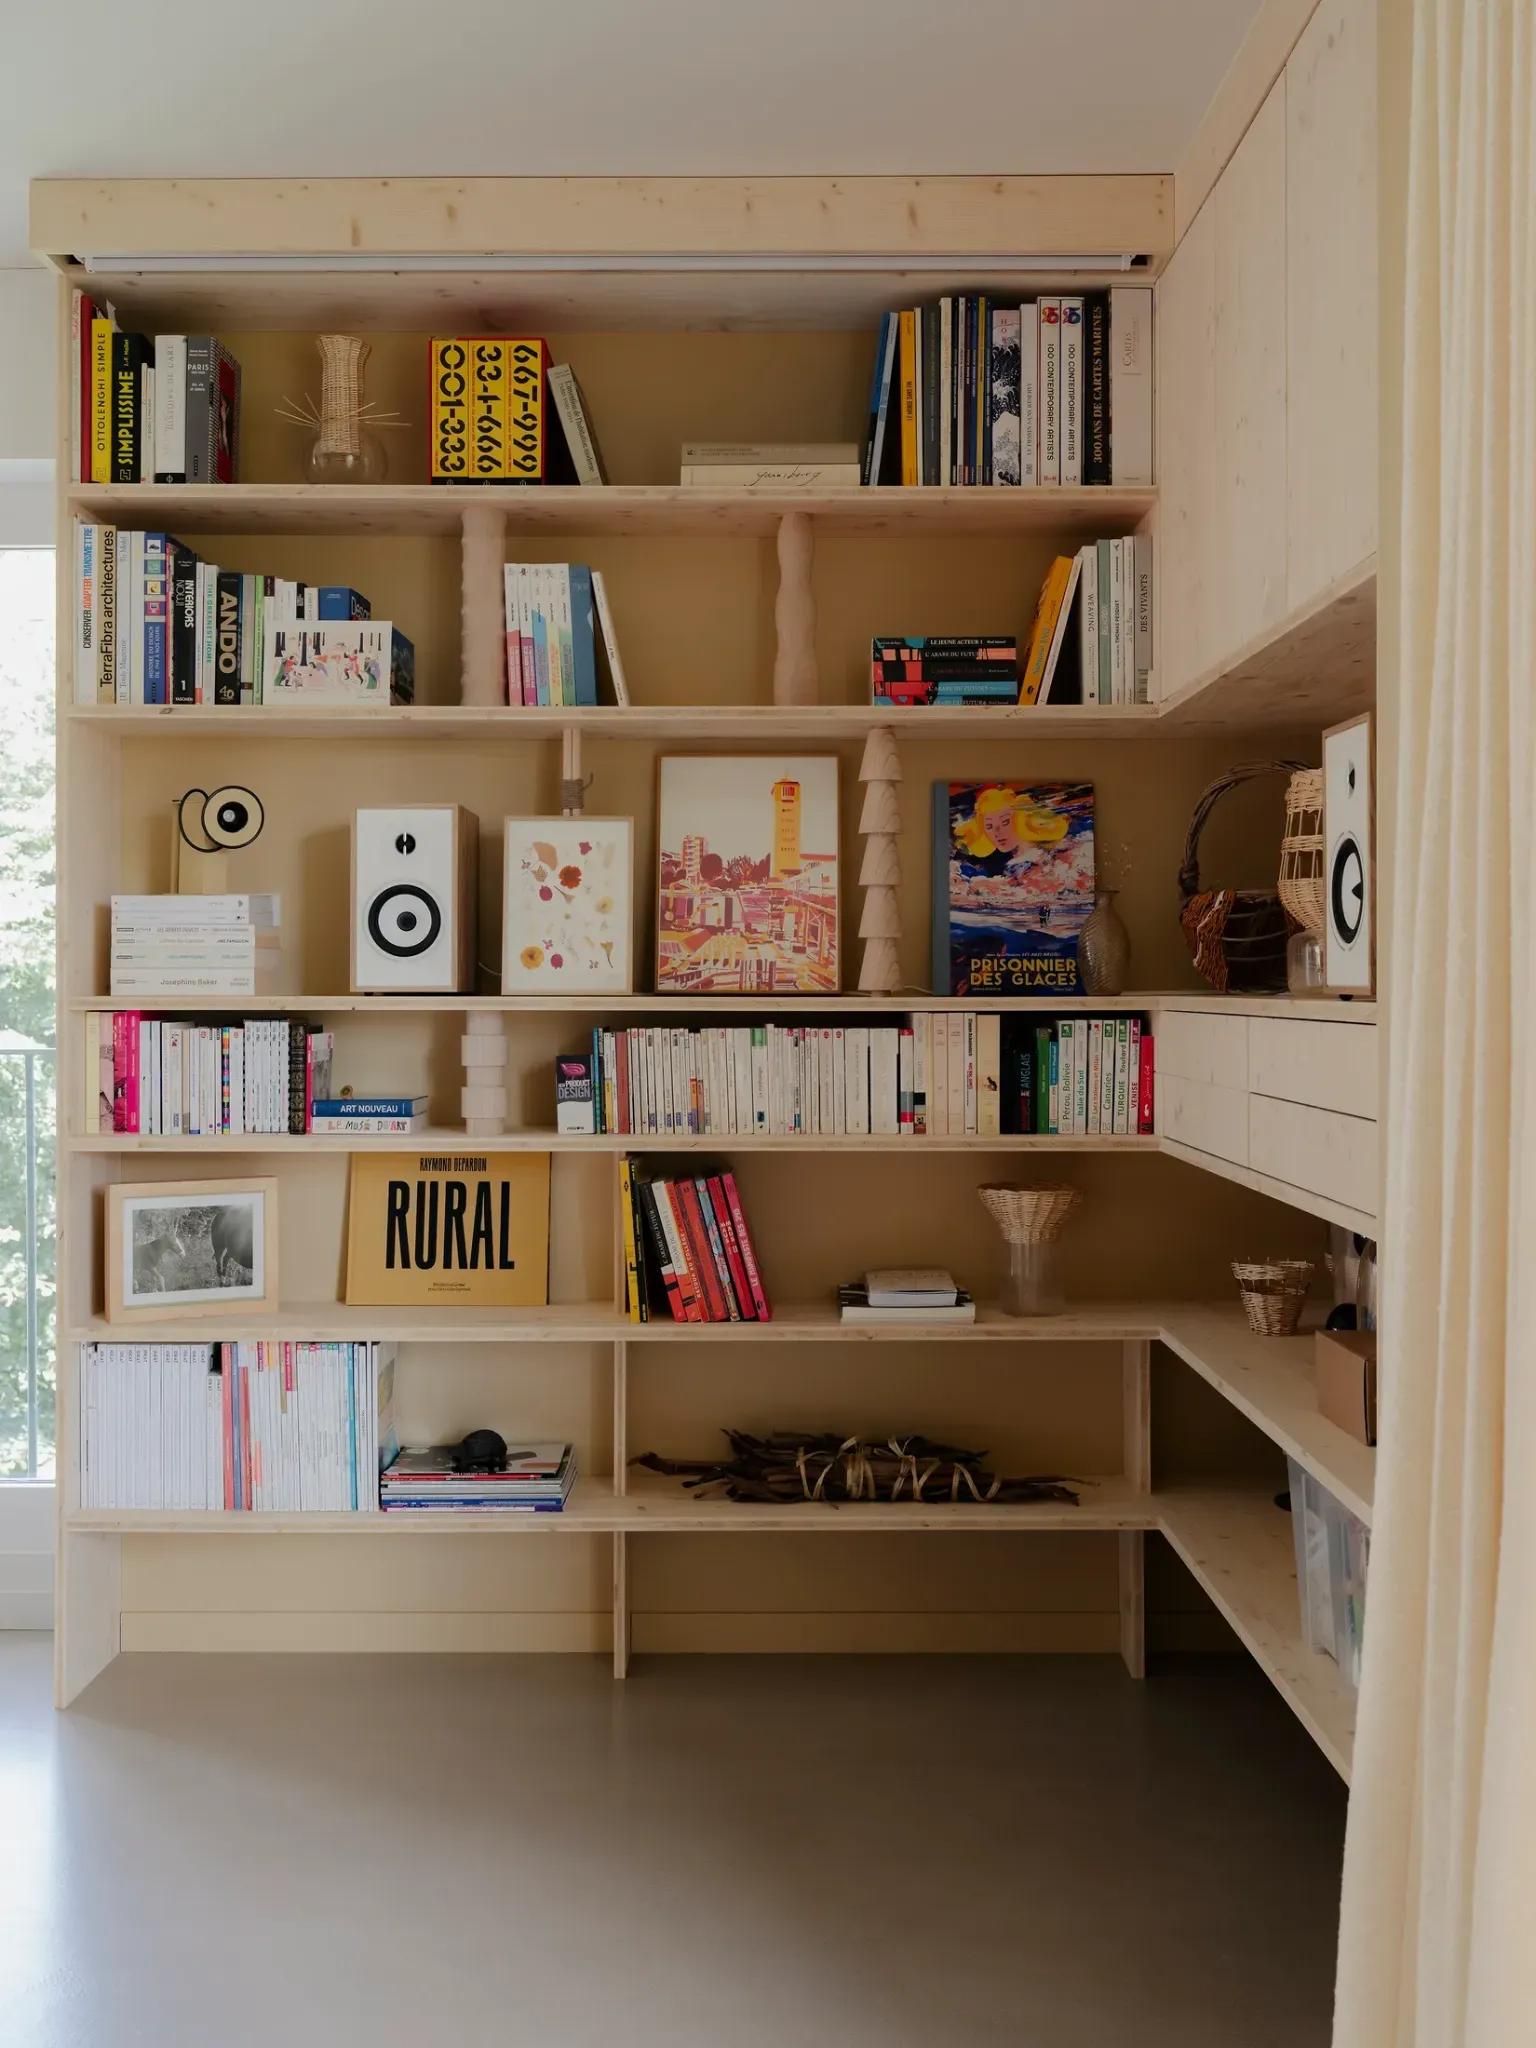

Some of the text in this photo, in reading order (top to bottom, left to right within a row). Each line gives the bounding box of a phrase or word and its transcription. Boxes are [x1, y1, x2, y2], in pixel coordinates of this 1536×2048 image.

[1093, 306, 1103, 356] MARINES
[97, 332, 106, 452] OTTOLENGHI SIMPLE
[1093, 358, 1103, 400] CARTES
[118, 370, 134, 465] SIMPLISSIME
[476, 345, 502, 473] 334-666
[513, 344, 539, 473] 667-999
[1093, 404, 1103, 418] DE
[83, 527, 92, 648] CONSERVER ADAPTER TRANSMETTRE
[100, 531, 114, 688] TerraFibra architectures
[184, 580, 194, 628] INTERIORS
[1140, 574, 1148, 632] DES VIVANTS
[219, 591, 238, 674] ANDO
[970, 959, 1076, 972] PRISONNIER
[970, 972, 1077, 986] DES GLACES
[558, 1087, 591, 1099] DESIGN
[566, 1080, 590, 1088] PRODUCT
[1021, 1053, 1031, 1088] ANGLAIS
[1062, 1063, 1071, 1092] Bolivie
[420, 1157, 487, 1172] RAYMOND DEPARDON
[385, 1180, 515, 1270] RURAL
